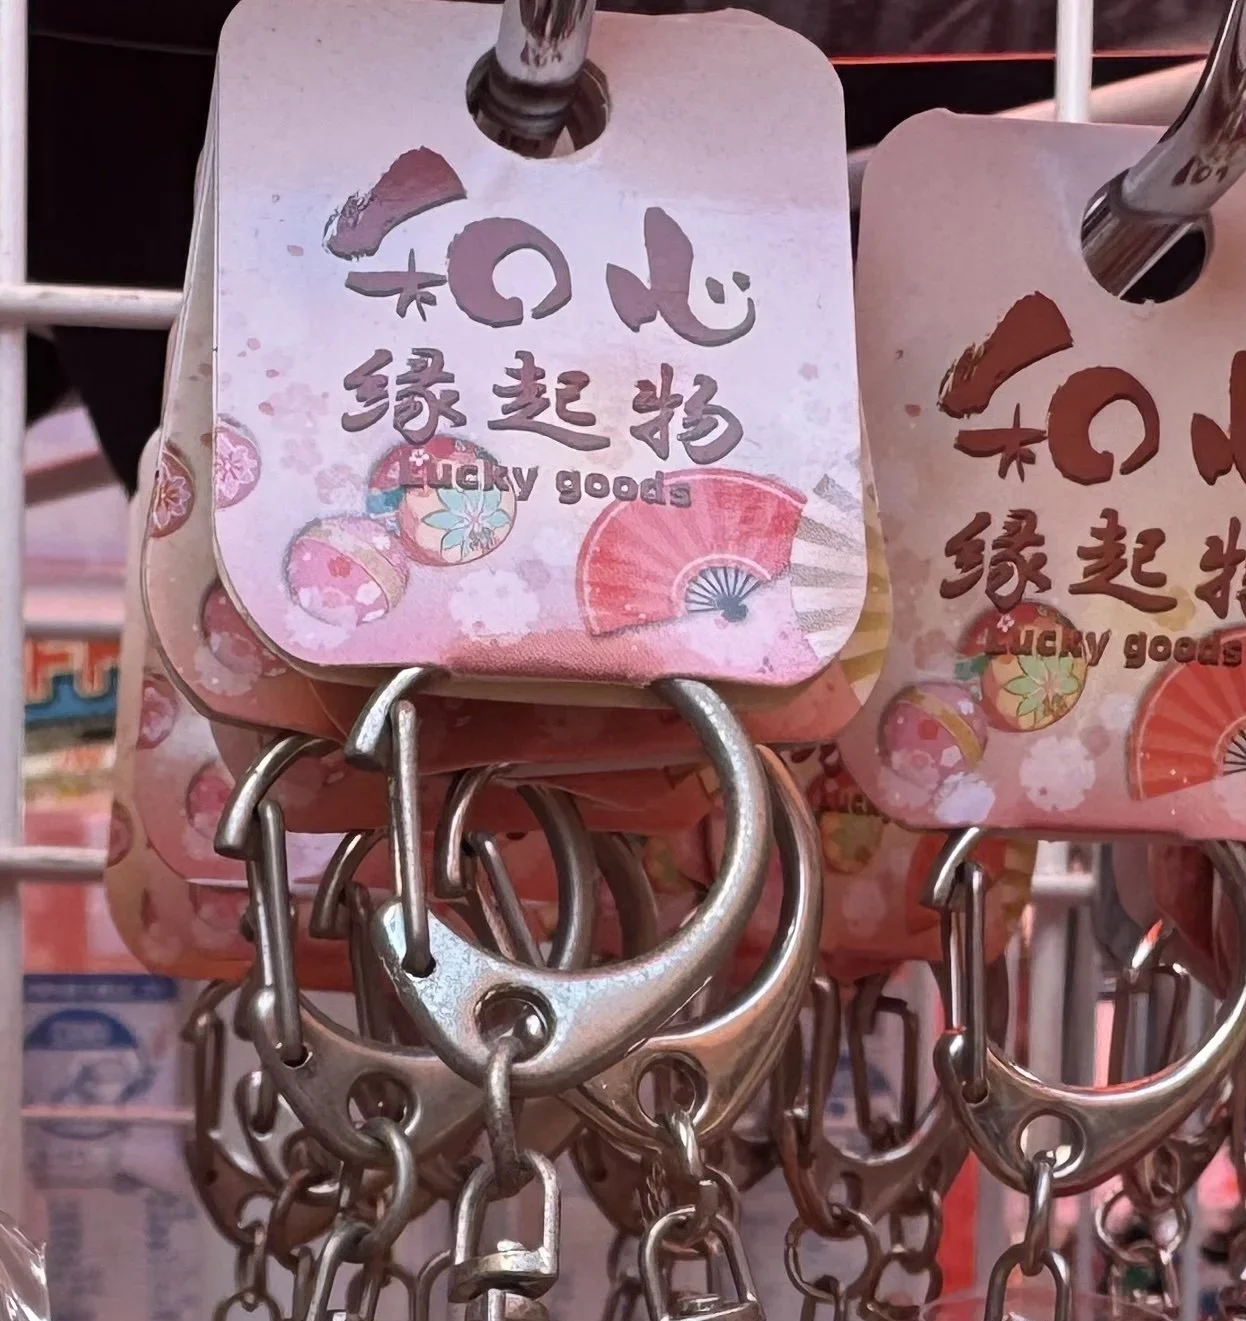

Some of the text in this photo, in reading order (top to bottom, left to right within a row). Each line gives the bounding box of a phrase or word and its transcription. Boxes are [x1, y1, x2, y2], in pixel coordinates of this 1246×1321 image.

[340, 348, 745, 466] 縁起物
[398, 456, 692, 509] Lucky goods
[984, 626, 1243, 669] Lucky goods
